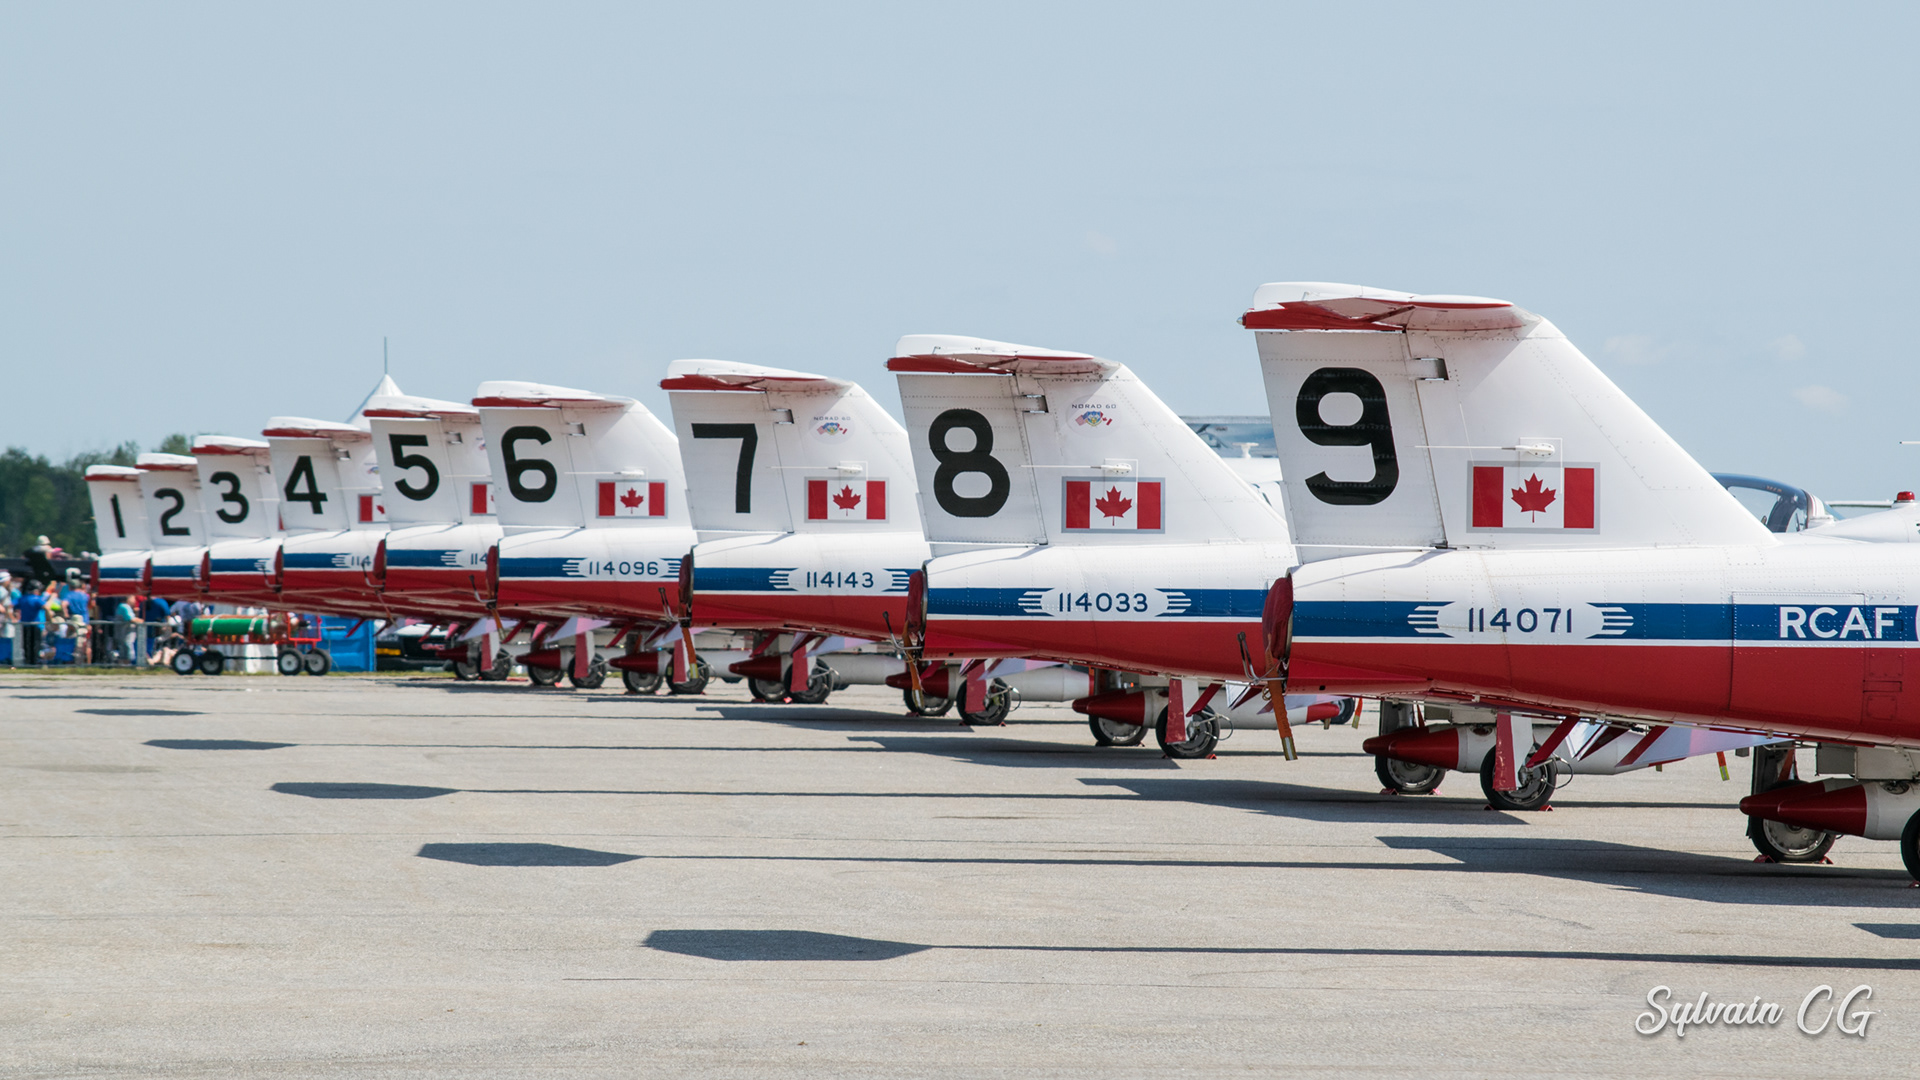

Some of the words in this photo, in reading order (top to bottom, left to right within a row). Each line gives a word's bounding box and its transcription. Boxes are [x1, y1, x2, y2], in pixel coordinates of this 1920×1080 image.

[1295, 366, 1400, 506] 9
[283, 455, 328, 515] 4
[388, 433, 440, 502] 5
[500, 425, 558, 503] 6
[690, 422, 759, 514] 7
[928, 407, 1011, 518] 8
[110, 493, 127, 539] 1
[153, 487, 191, 537] 2
[209, 471, 250, 524] 3
[588, 560, 659, 576] 114096
[805, 570, 875, 589] 114143
[1058, 592, 1149, 613] 114033
[1467, 606, 1573, 634] 114071
[1779, 606, 1900, 639] RCAF
